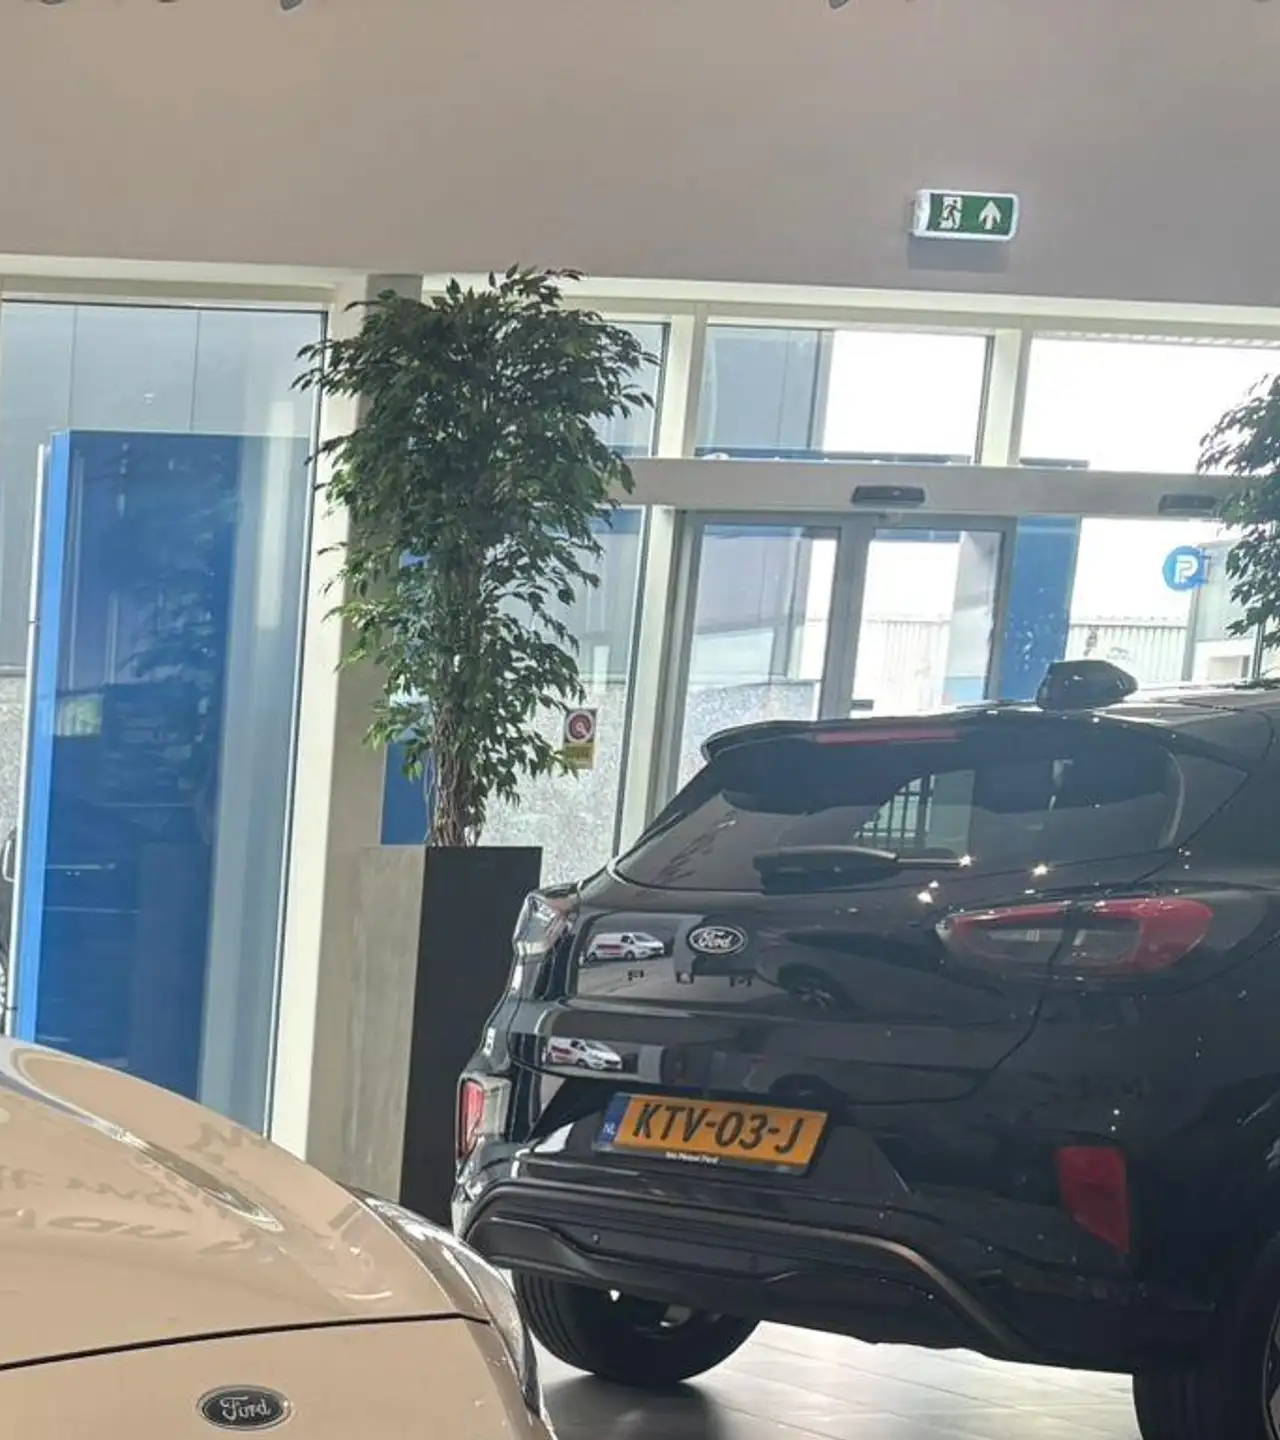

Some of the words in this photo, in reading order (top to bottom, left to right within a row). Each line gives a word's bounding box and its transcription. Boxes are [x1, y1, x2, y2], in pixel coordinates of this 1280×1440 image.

[698, 928, 735, 949] Ford
[632, 1102, 804, 1154] KTV-03-J
[219, 1395, 272, 1421] Ford
